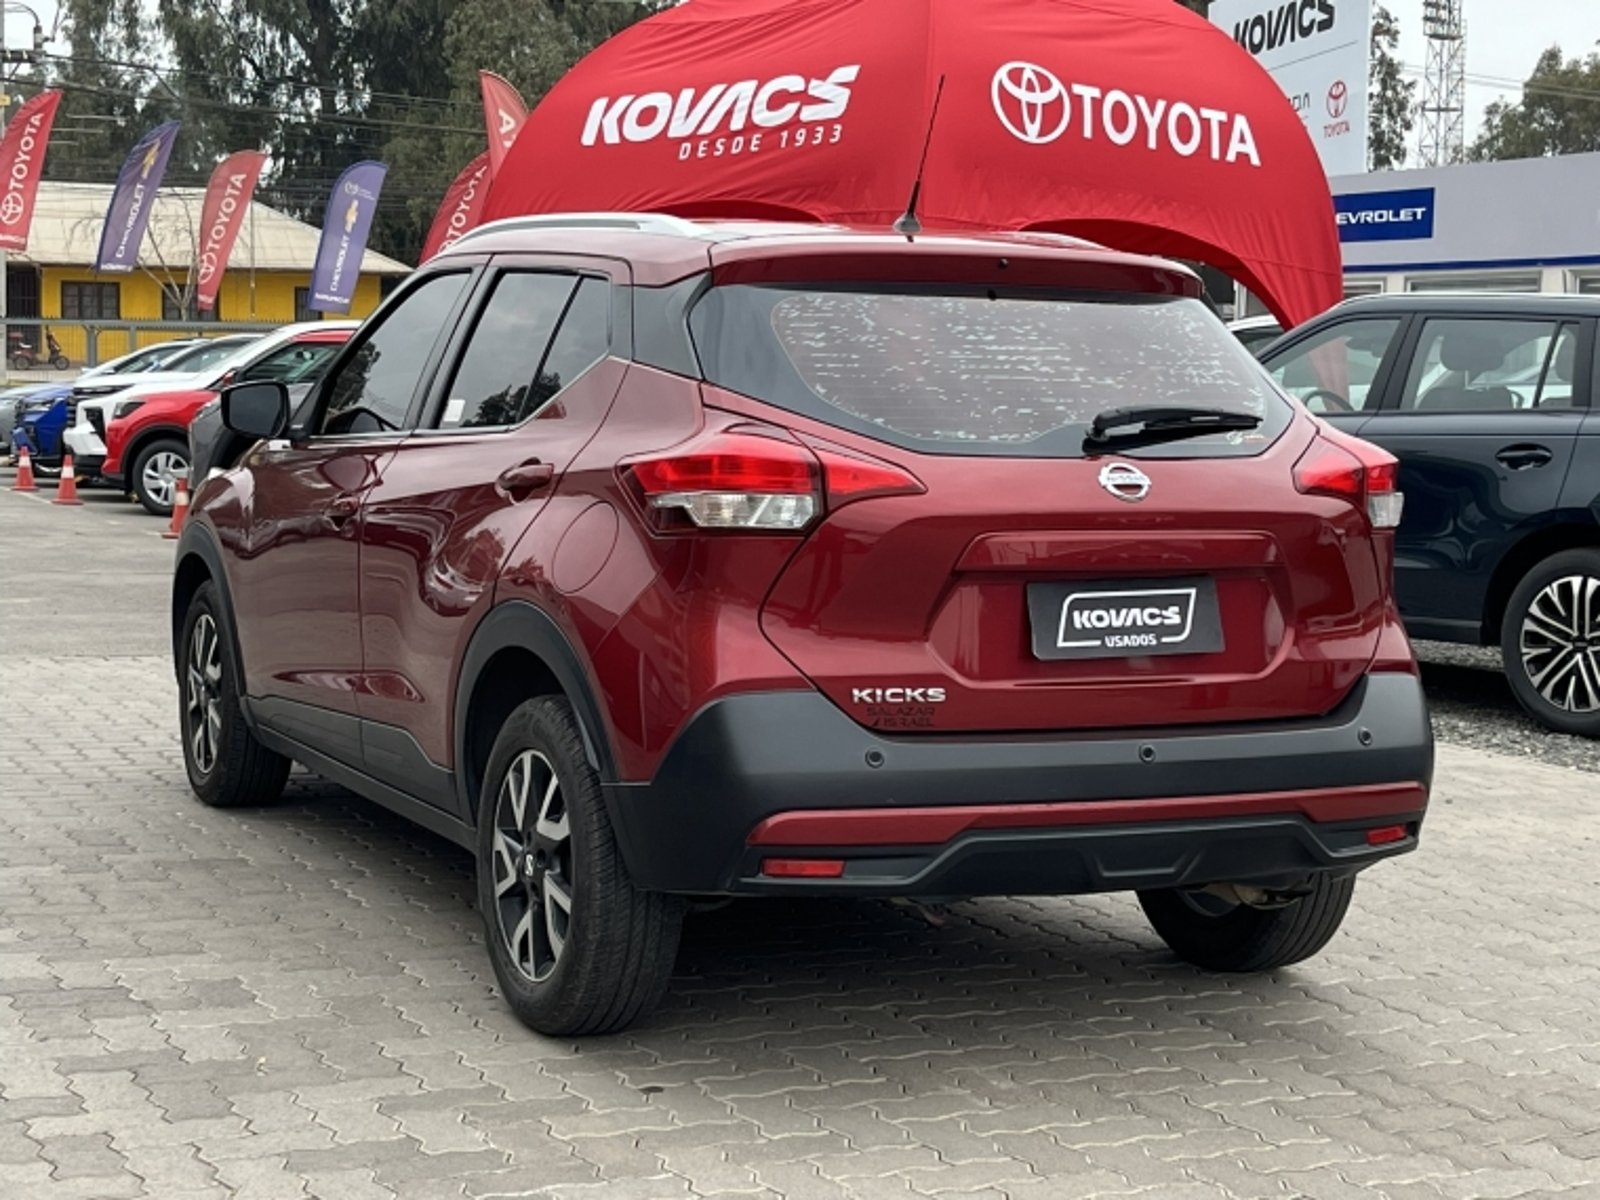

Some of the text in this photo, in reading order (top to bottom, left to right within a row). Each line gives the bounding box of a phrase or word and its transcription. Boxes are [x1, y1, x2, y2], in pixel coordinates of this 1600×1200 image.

[1234, 0, 1335, 55] KOVACS
[580, 64, 861, 146] KOVACS
[1070, 83, 1262, 167] TOYOTA
[9, 112, 44, 190] TOYOTA
[678, 124, 842, 160] DESDE 1933
[206, 173, 247, 250] TOYOTA
[1335, 206, 1426, 225] EVROLET
[330, 235, 350, 291] CHEVROLET
[1073, 606, 1181, 629] KOVACS
[1105, 633, 1157, 647] USADOS
[852, 687, 946, 703] KICKS
